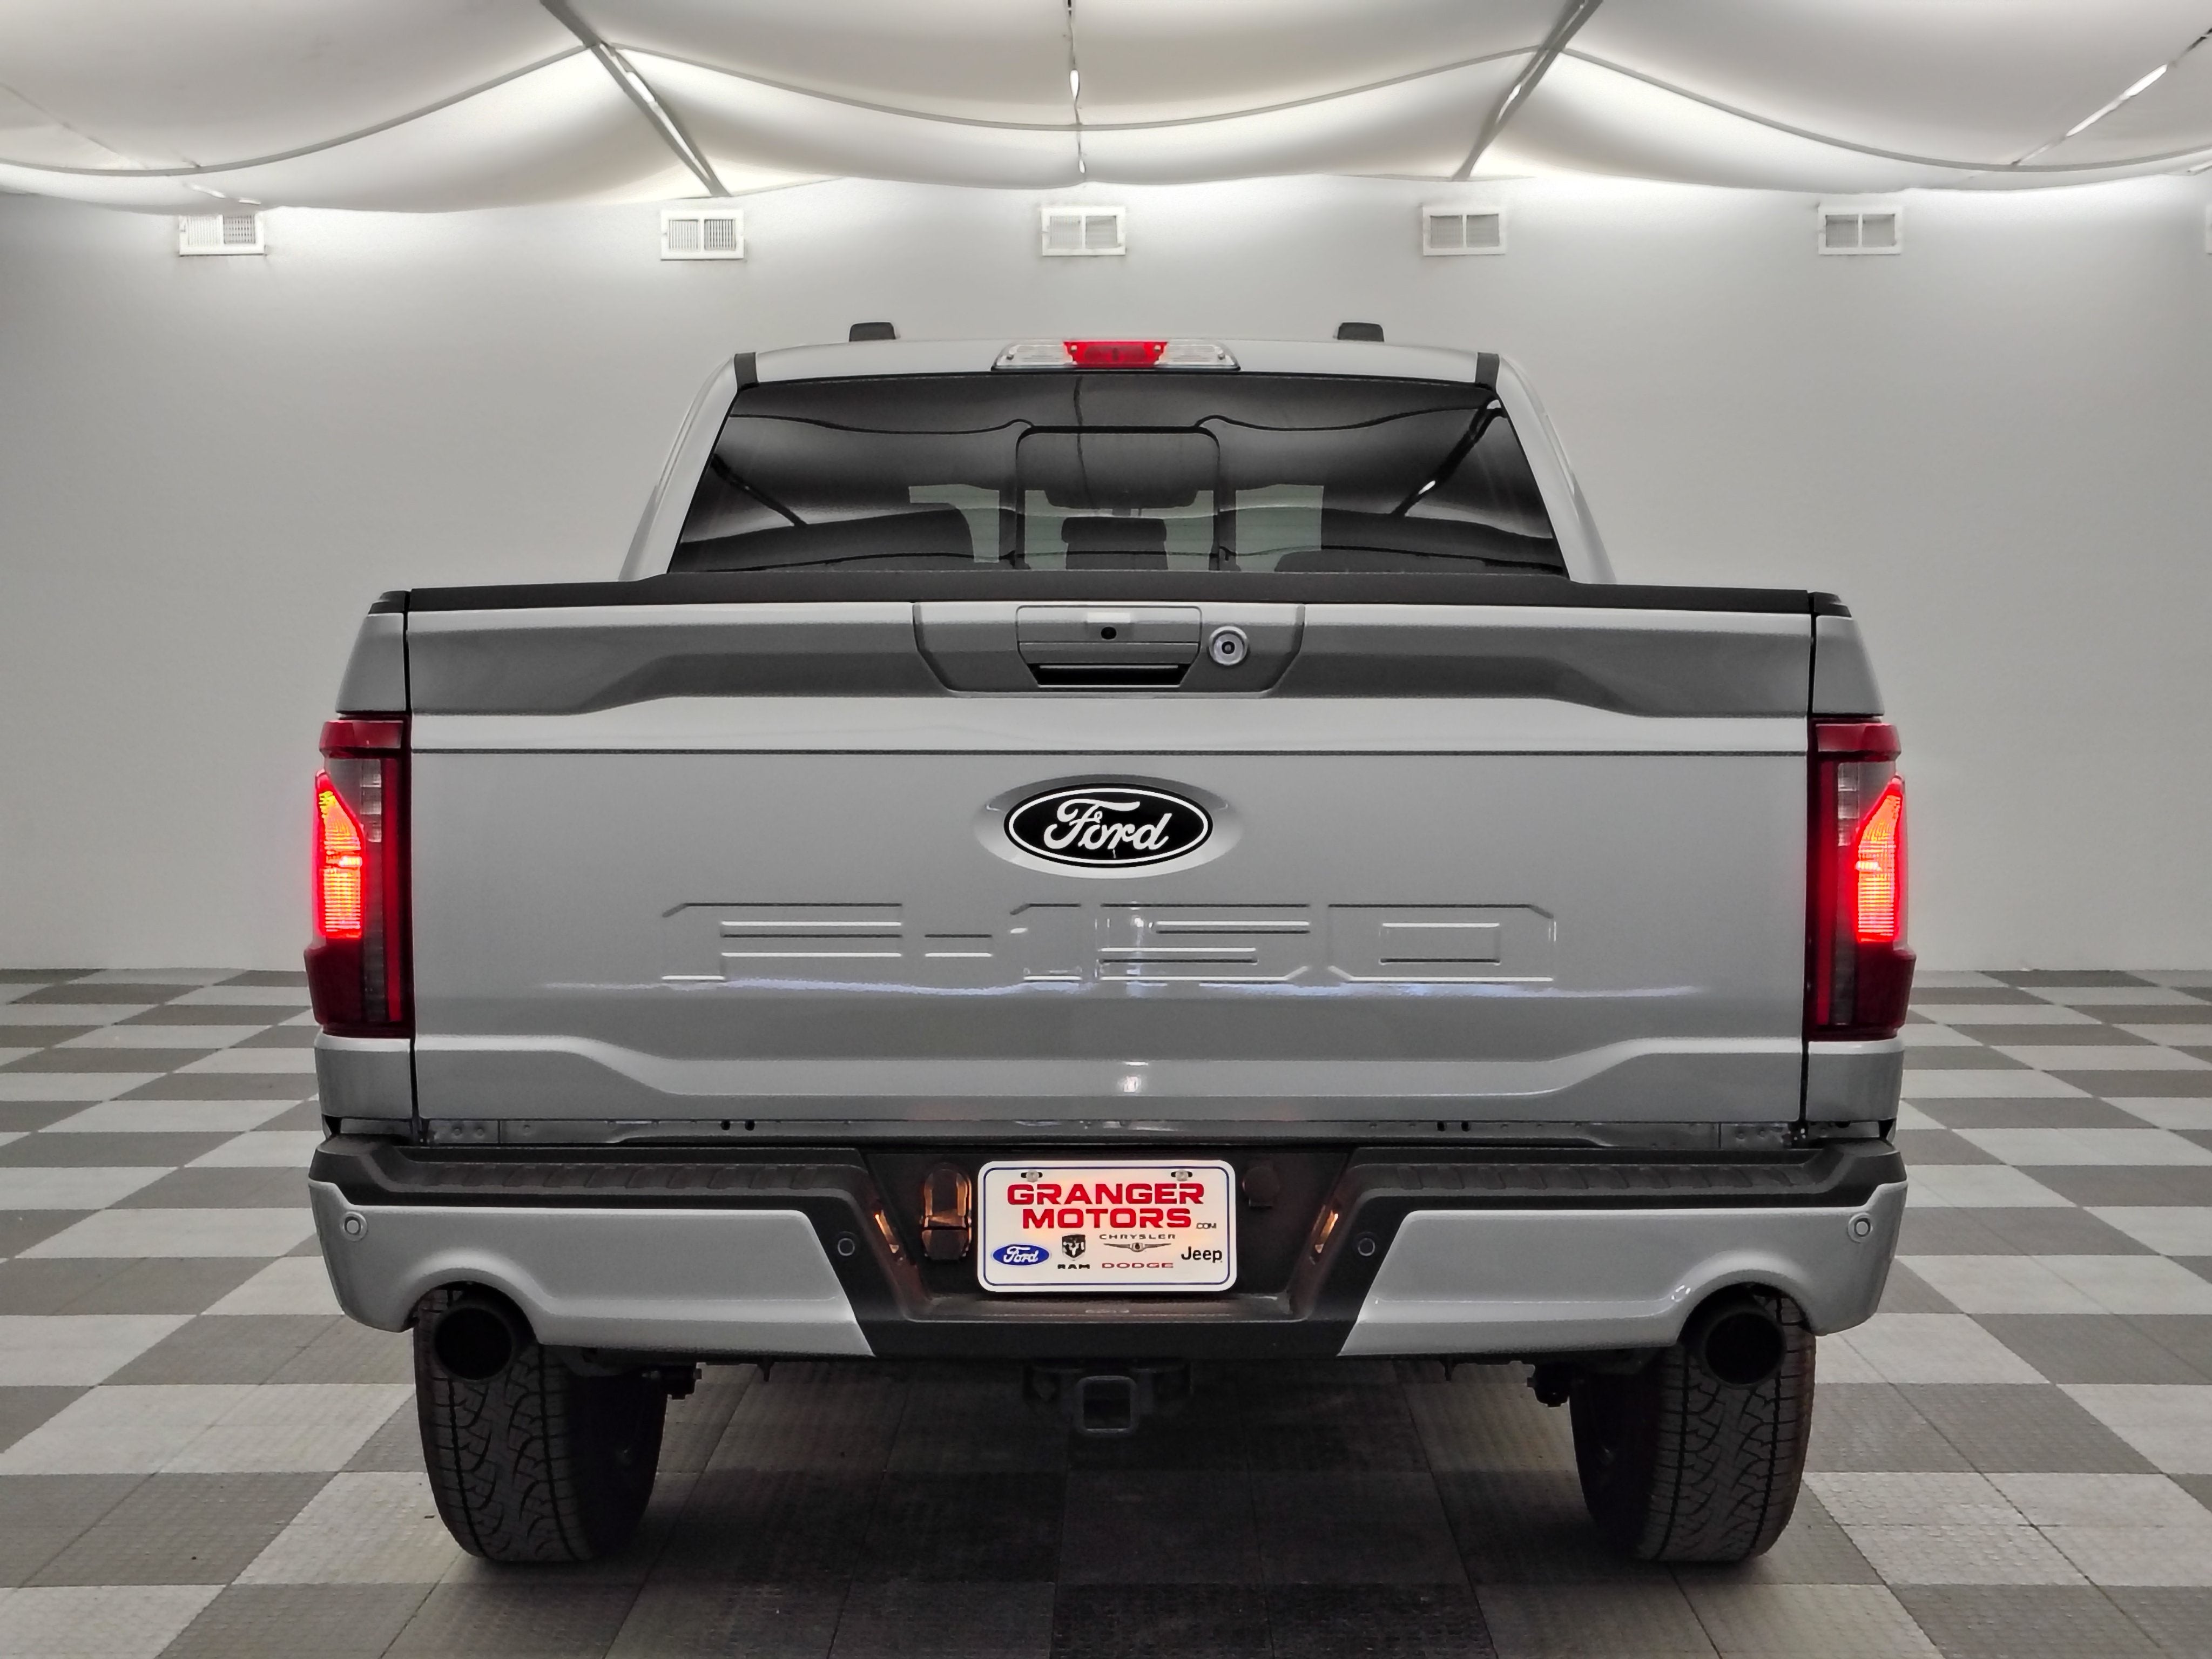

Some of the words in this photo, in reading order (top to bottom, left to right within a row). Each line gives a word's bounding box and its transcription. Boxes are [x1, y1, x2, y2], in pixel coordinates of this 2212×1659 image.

[1043, 798, 1172, 850] Ford
[1007, 1183, 1204, 1205] GRANGER
[1022, 1208, 1191, 1229] MOTORS
[1004, 1246, 1039, 1263] Ford
[1181, 1246, 1223, 1263] Jeep
